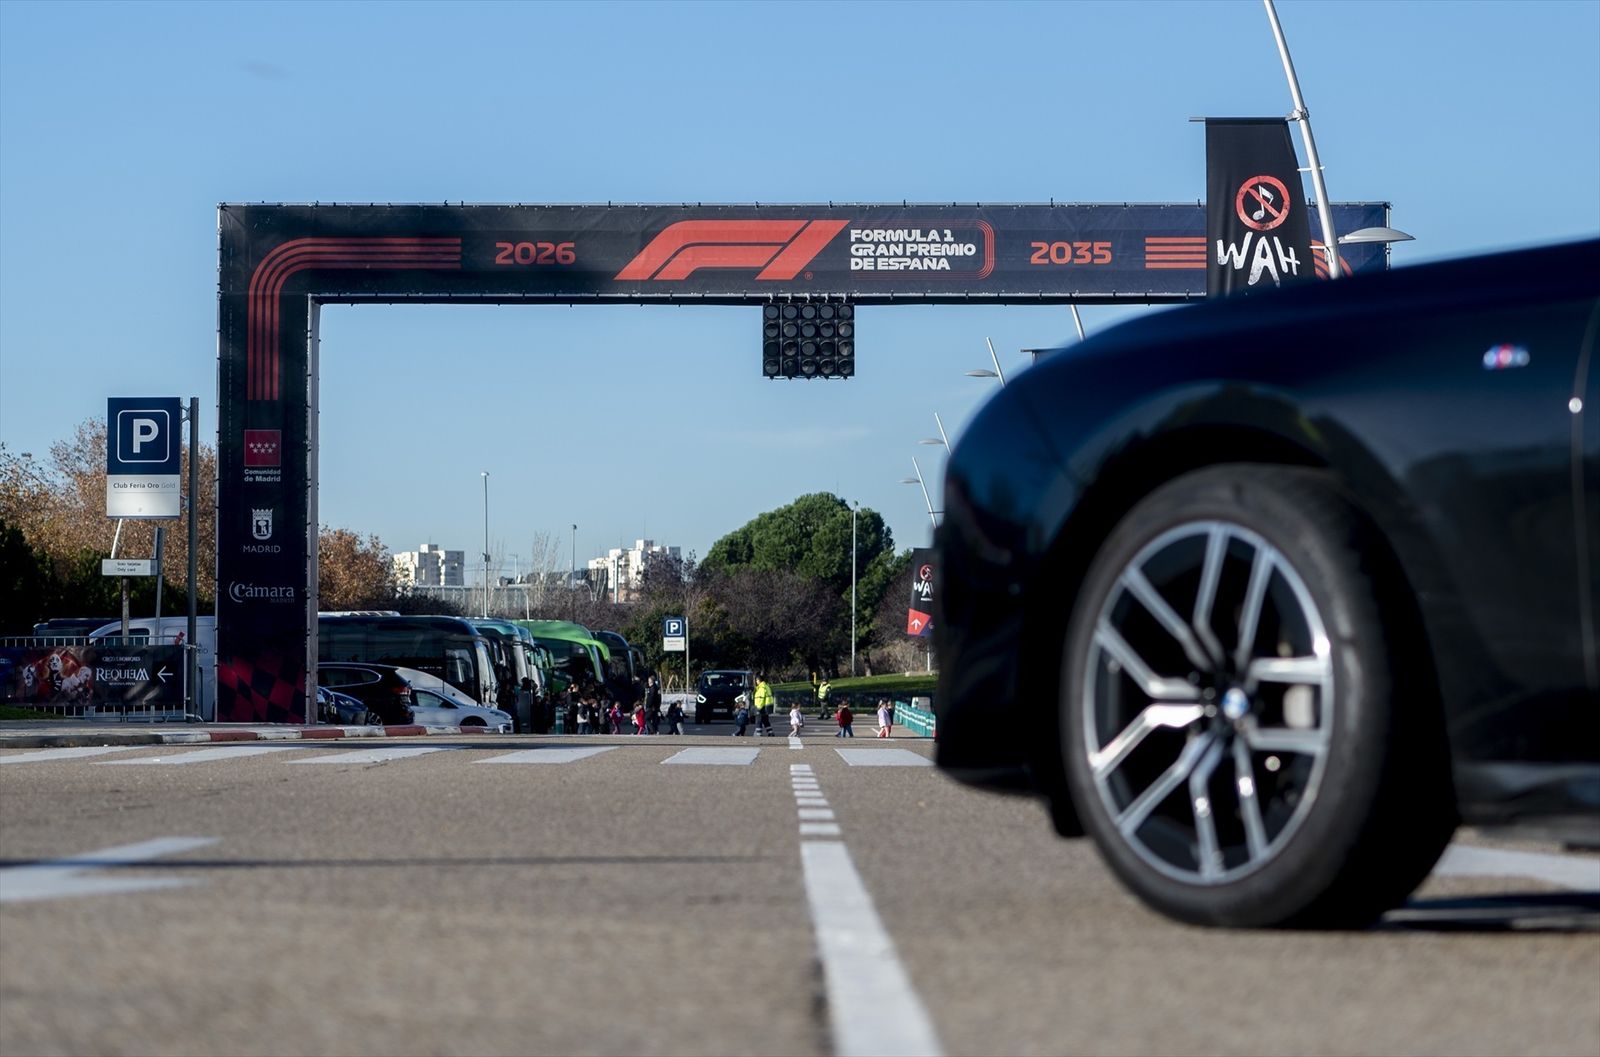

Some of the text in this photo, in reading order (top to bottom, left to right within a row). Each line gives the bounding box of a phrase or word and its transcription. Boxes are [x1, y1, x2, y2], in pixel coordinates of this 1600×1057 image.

[850, 229, 954, 243] FORMULA 1
[495, 242, 576, 266] 2026
[613, 219, 850, 281] F1
[850, 243, 977, 256] GRAN PREMIO
[1030, 241, 1112, 265] 2035
[850, 257, 951, 271] DE ESPAÑA
[1216, 231, 1301, 288] WAH
[132, 418, 159, 454] P
[243, 545, 281, 553] MADRID
[233, 581, 295, 598] Cámara
[670, 622, 679, 634] P
